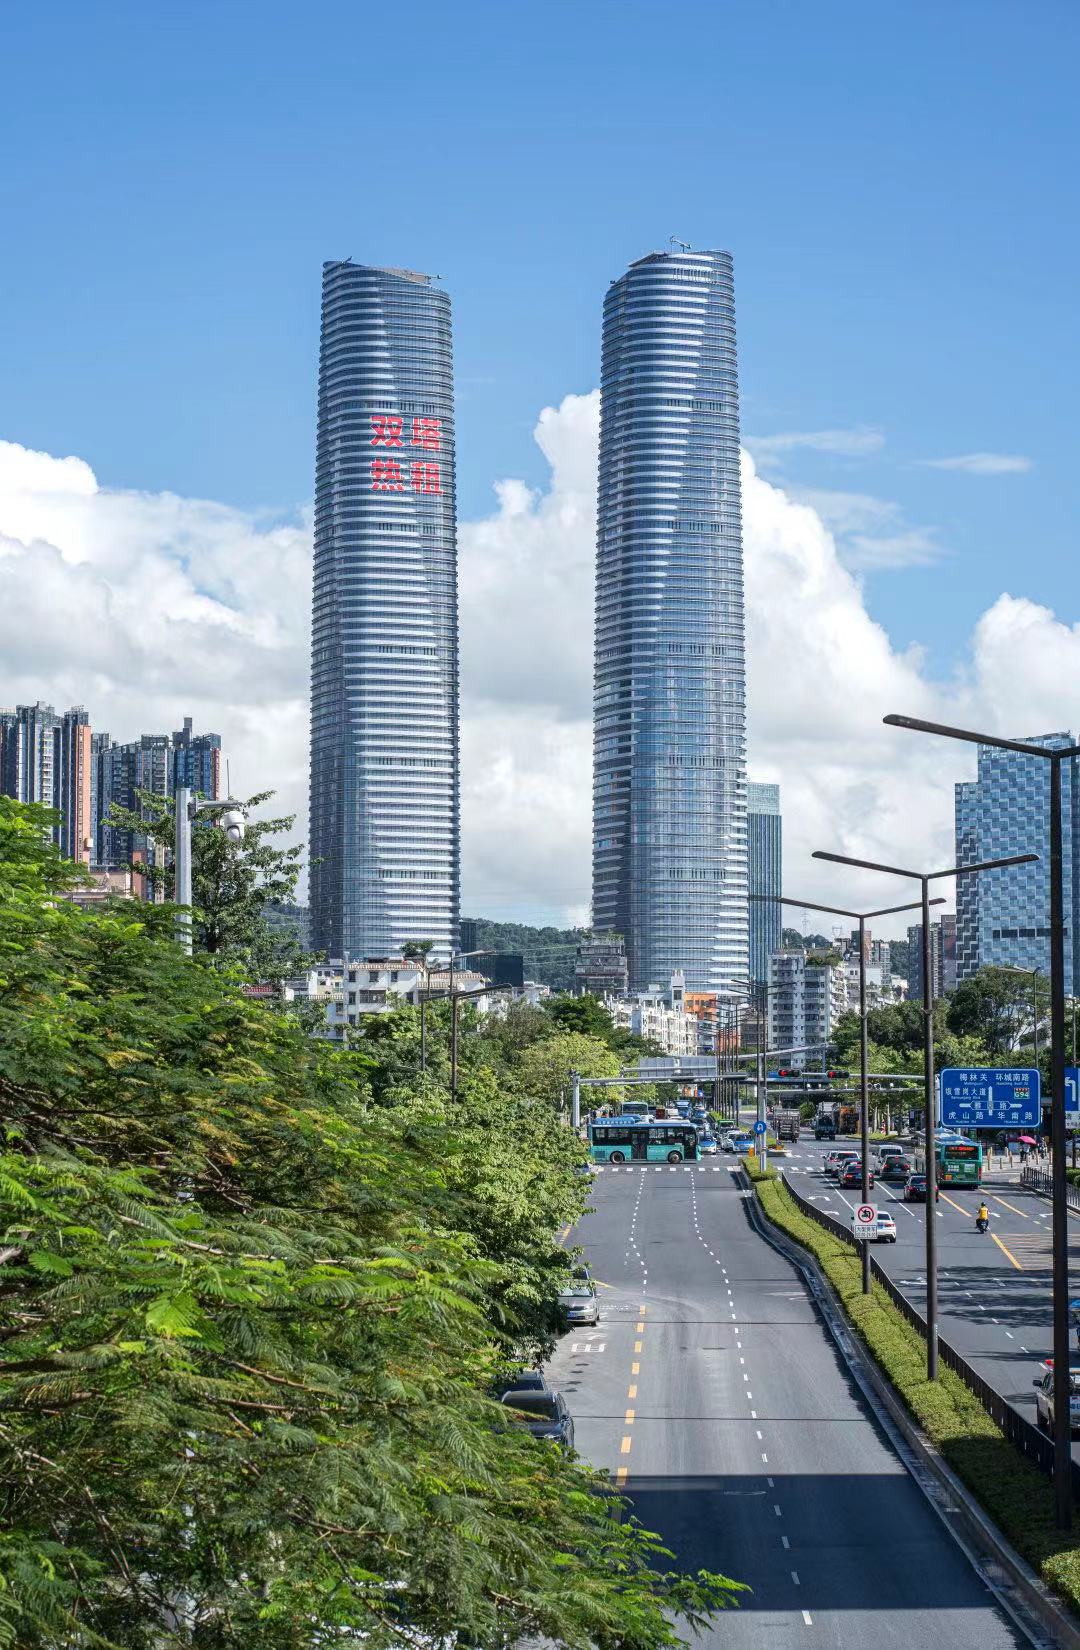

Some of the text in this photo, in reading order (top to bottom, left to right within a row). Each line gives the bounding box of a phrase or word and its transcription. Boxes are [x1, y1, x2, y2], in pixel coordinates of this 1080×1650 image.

[370, 415, 443, 450] 双塔
[370, 458, 444, 494] 热租
[959, 1073, 988, 1082] 梅林关
[995, 1073, 1030, 1082] 环城南路
[948, 1111, 984, 1120] 虎山路
[997, 1111, 1033, 1120] 华南路
